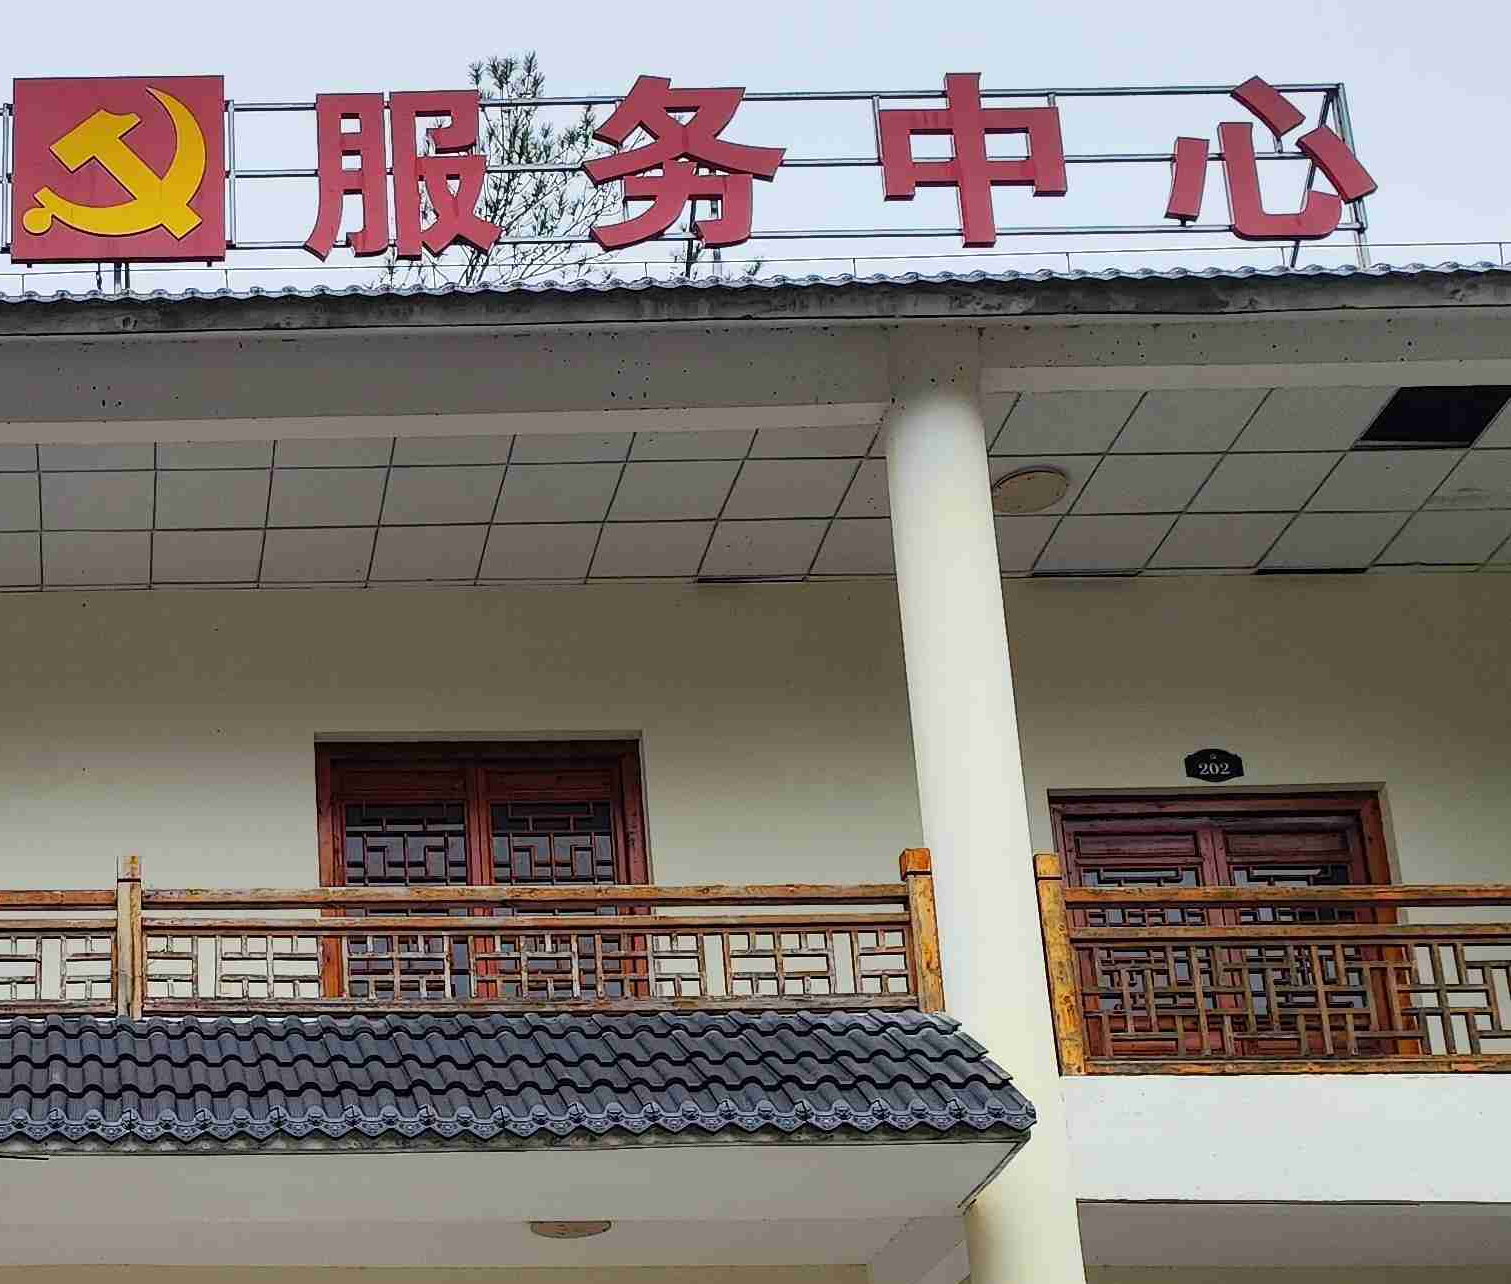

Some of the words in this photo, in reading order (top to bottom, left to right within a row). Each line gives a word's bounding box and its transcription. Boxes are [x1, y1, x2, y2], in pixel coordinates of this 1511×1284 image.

[303, 72, 1378, 261] 服务中心
[1198, 762, 1231, 775] 202
